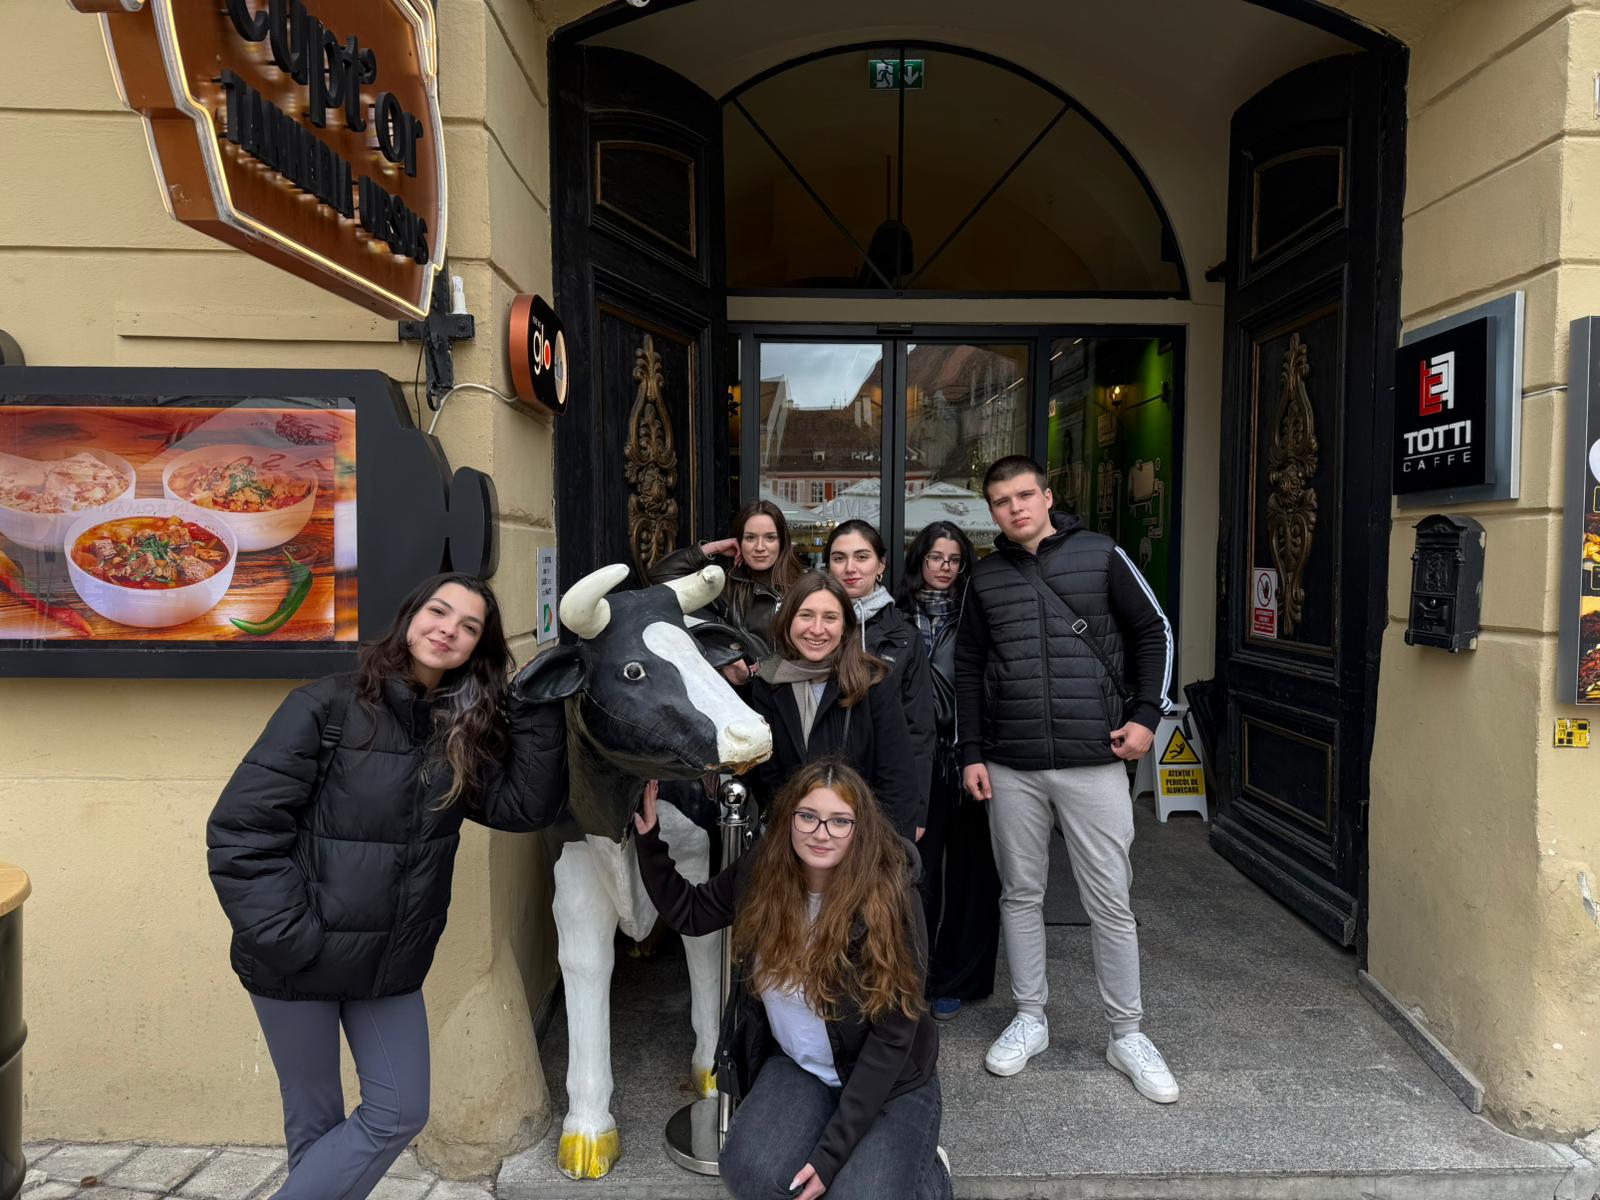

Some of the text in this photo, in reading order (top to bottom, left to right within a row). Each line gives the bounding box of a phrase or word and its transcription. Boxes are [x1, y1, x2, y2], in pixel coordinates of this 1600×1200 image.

[533, 323, 551, 376] glo
[1403, 419, 1472, 455] TOTTI
[1402, 451, 1472, 473] CAFFE
[1166, 778, 1190, 786] PERICOL
[1166, 786, 1199, 794] ALUNECARE
